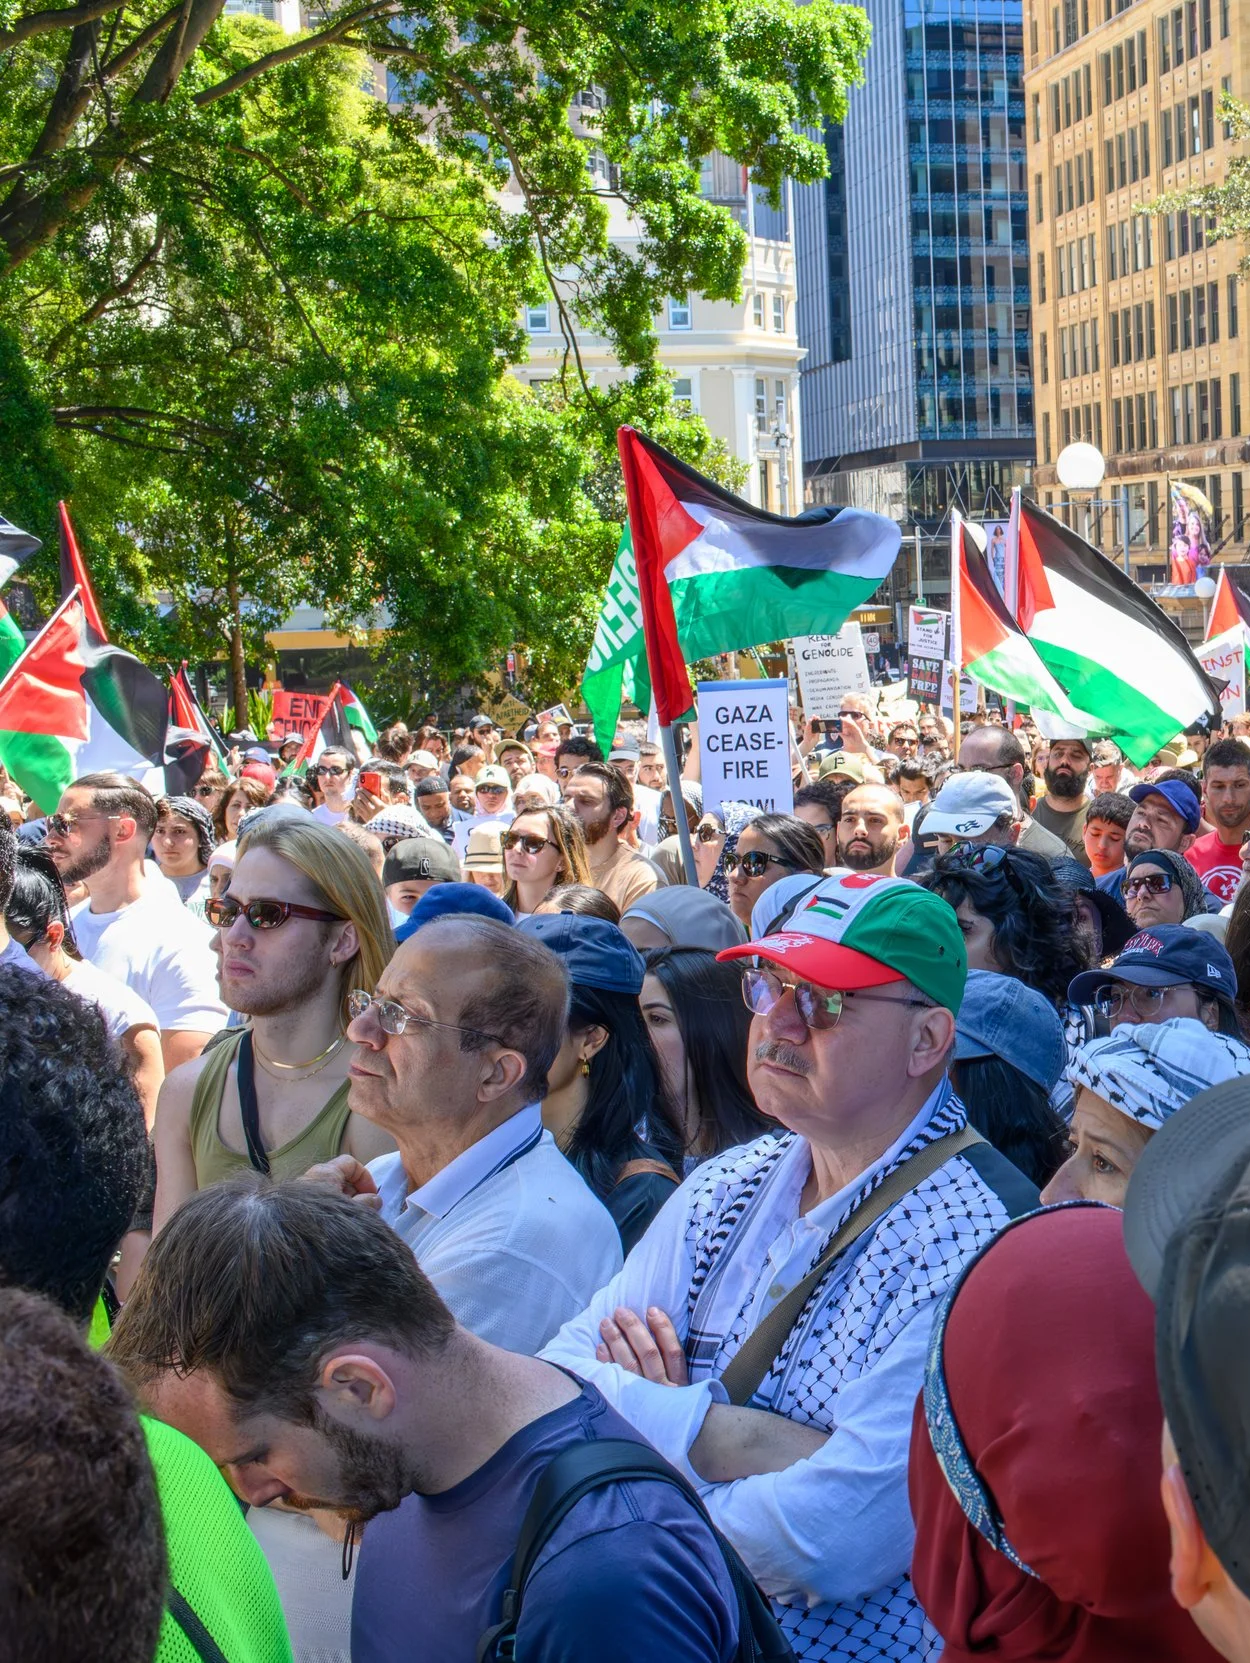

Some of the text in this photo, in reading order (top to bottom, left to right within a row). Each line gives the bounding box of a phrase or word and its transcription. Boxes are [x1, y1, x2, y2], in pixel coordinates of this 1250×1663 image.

[802, 647, 854, 660] GENOCIDE
[1202, 650, 1243, 671] INST
[912, 658, 940, 675] SAVE
[911, 669, 938, 683] GAZA
[911, 678, 938, 693] FREE
[715, 704, 773, 725] GAZA
[706, 732, 783, 752] CEASE-
[723, 760, 769, 779] FIRE
